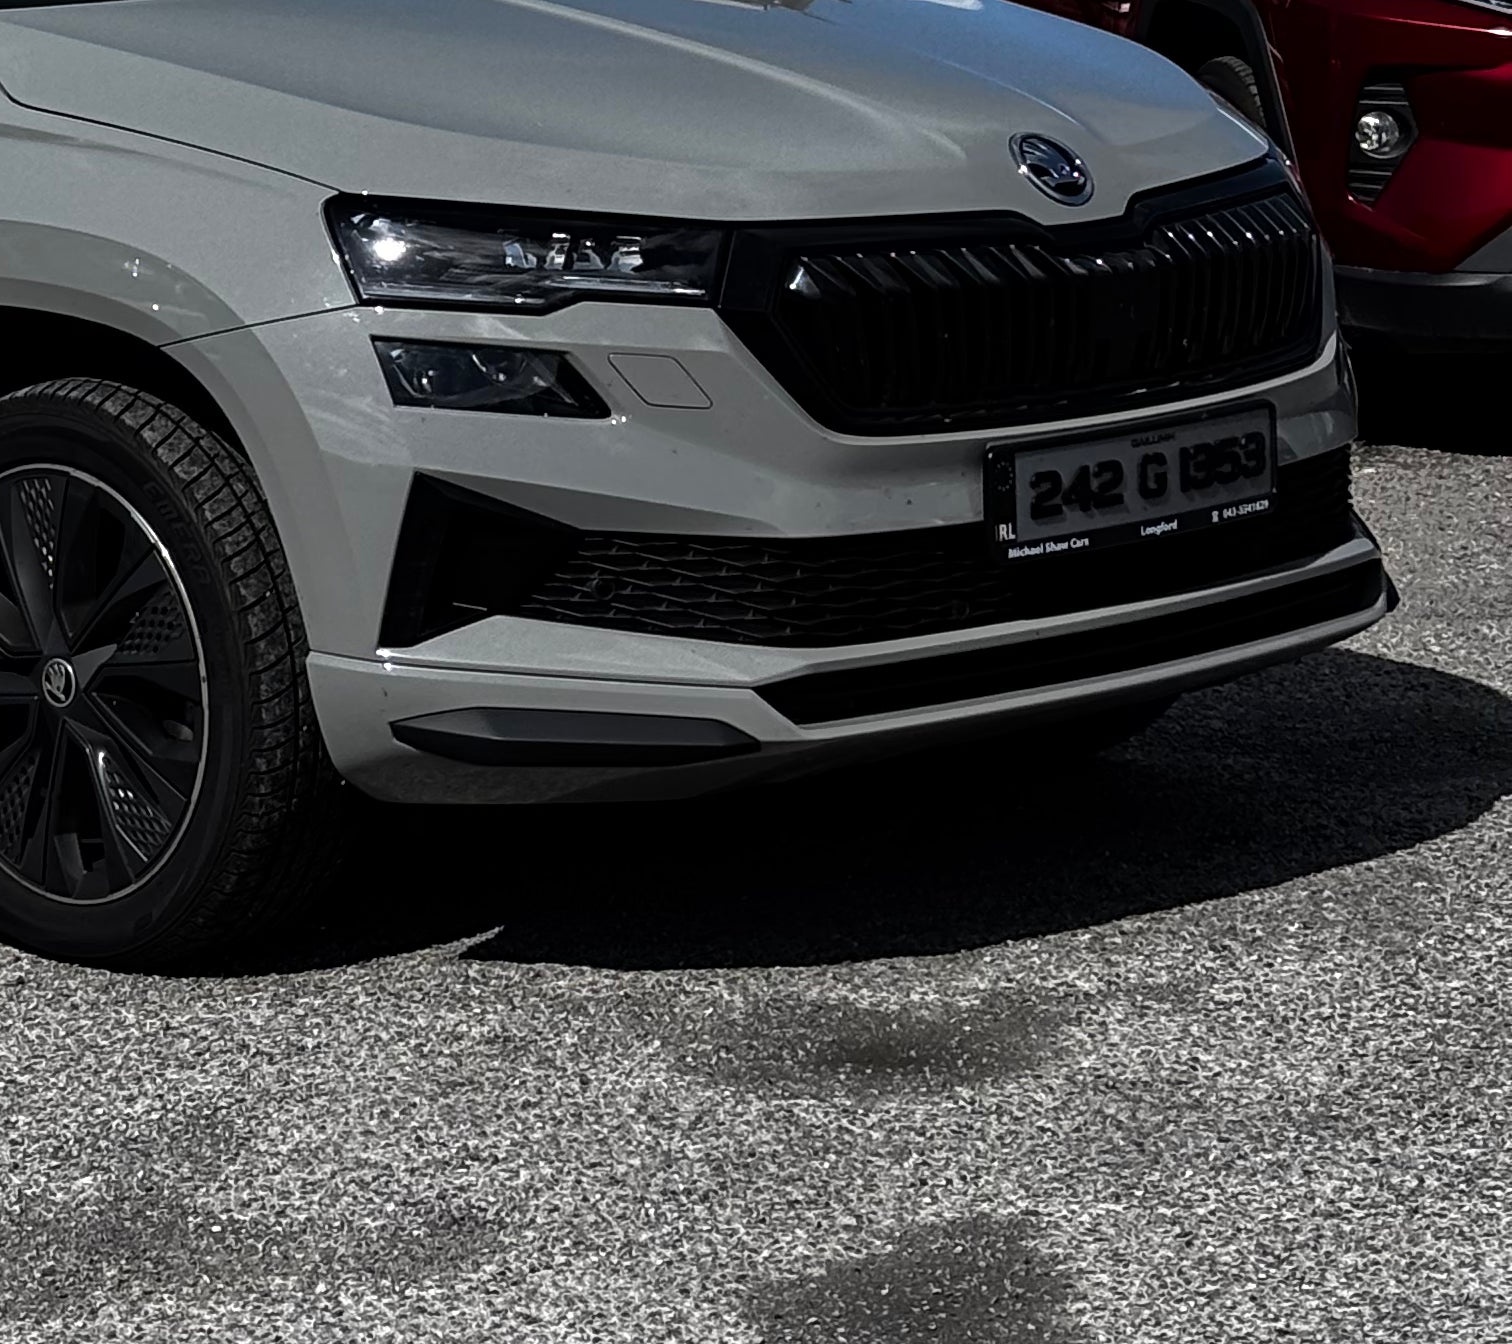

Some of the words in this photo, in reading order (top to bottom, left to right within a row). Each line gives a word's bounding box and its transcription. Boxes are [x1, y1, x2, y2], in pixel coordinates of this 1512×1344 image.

[1029, 459, 1125, 521] 242
[1138, 451, 1169, 501] G
[1179, 430, 1267, 494] 1353
[995, 521, 1017, 542] IRL
[1007, 541, 1045, 560] Michael
[1045, 539, 1069, 555] Shaw
[1140, 518, 1178, 538] Longford
